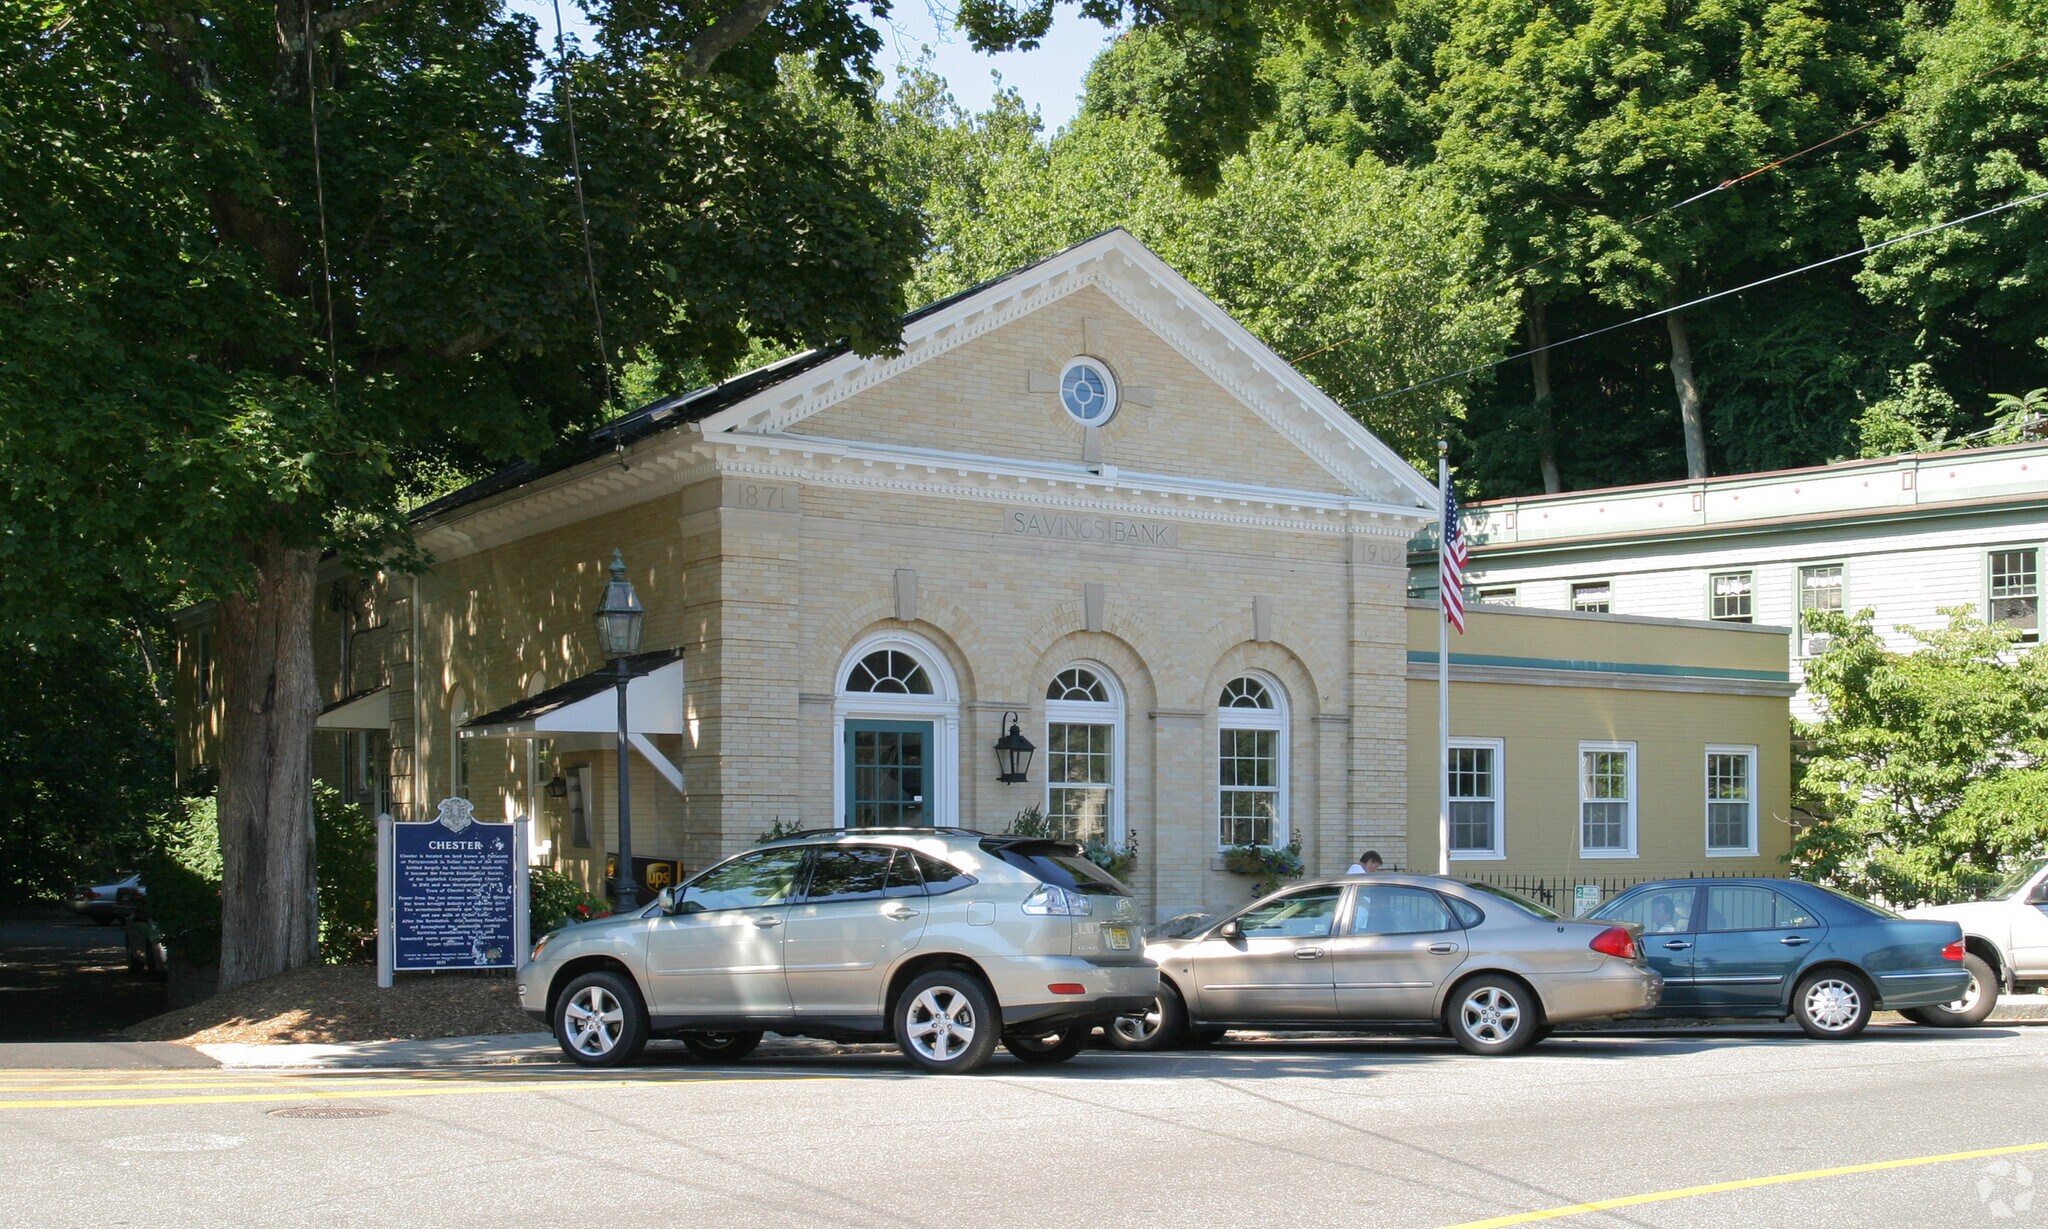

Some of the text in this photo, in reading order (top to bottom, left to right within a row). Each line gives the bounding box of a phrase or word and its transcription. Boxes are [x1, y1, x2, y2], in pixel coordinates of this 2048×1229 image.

[738, 484, 785, 509] 1871
[1013, 512, 1169, 546] SAVINGS BANK
[1362, 542, 1402, 564] 1902
[428, 840, 482, 850] CHESTER
[649, 871, 669, 889] ups
[1577, 888, 1583, 897] 2
